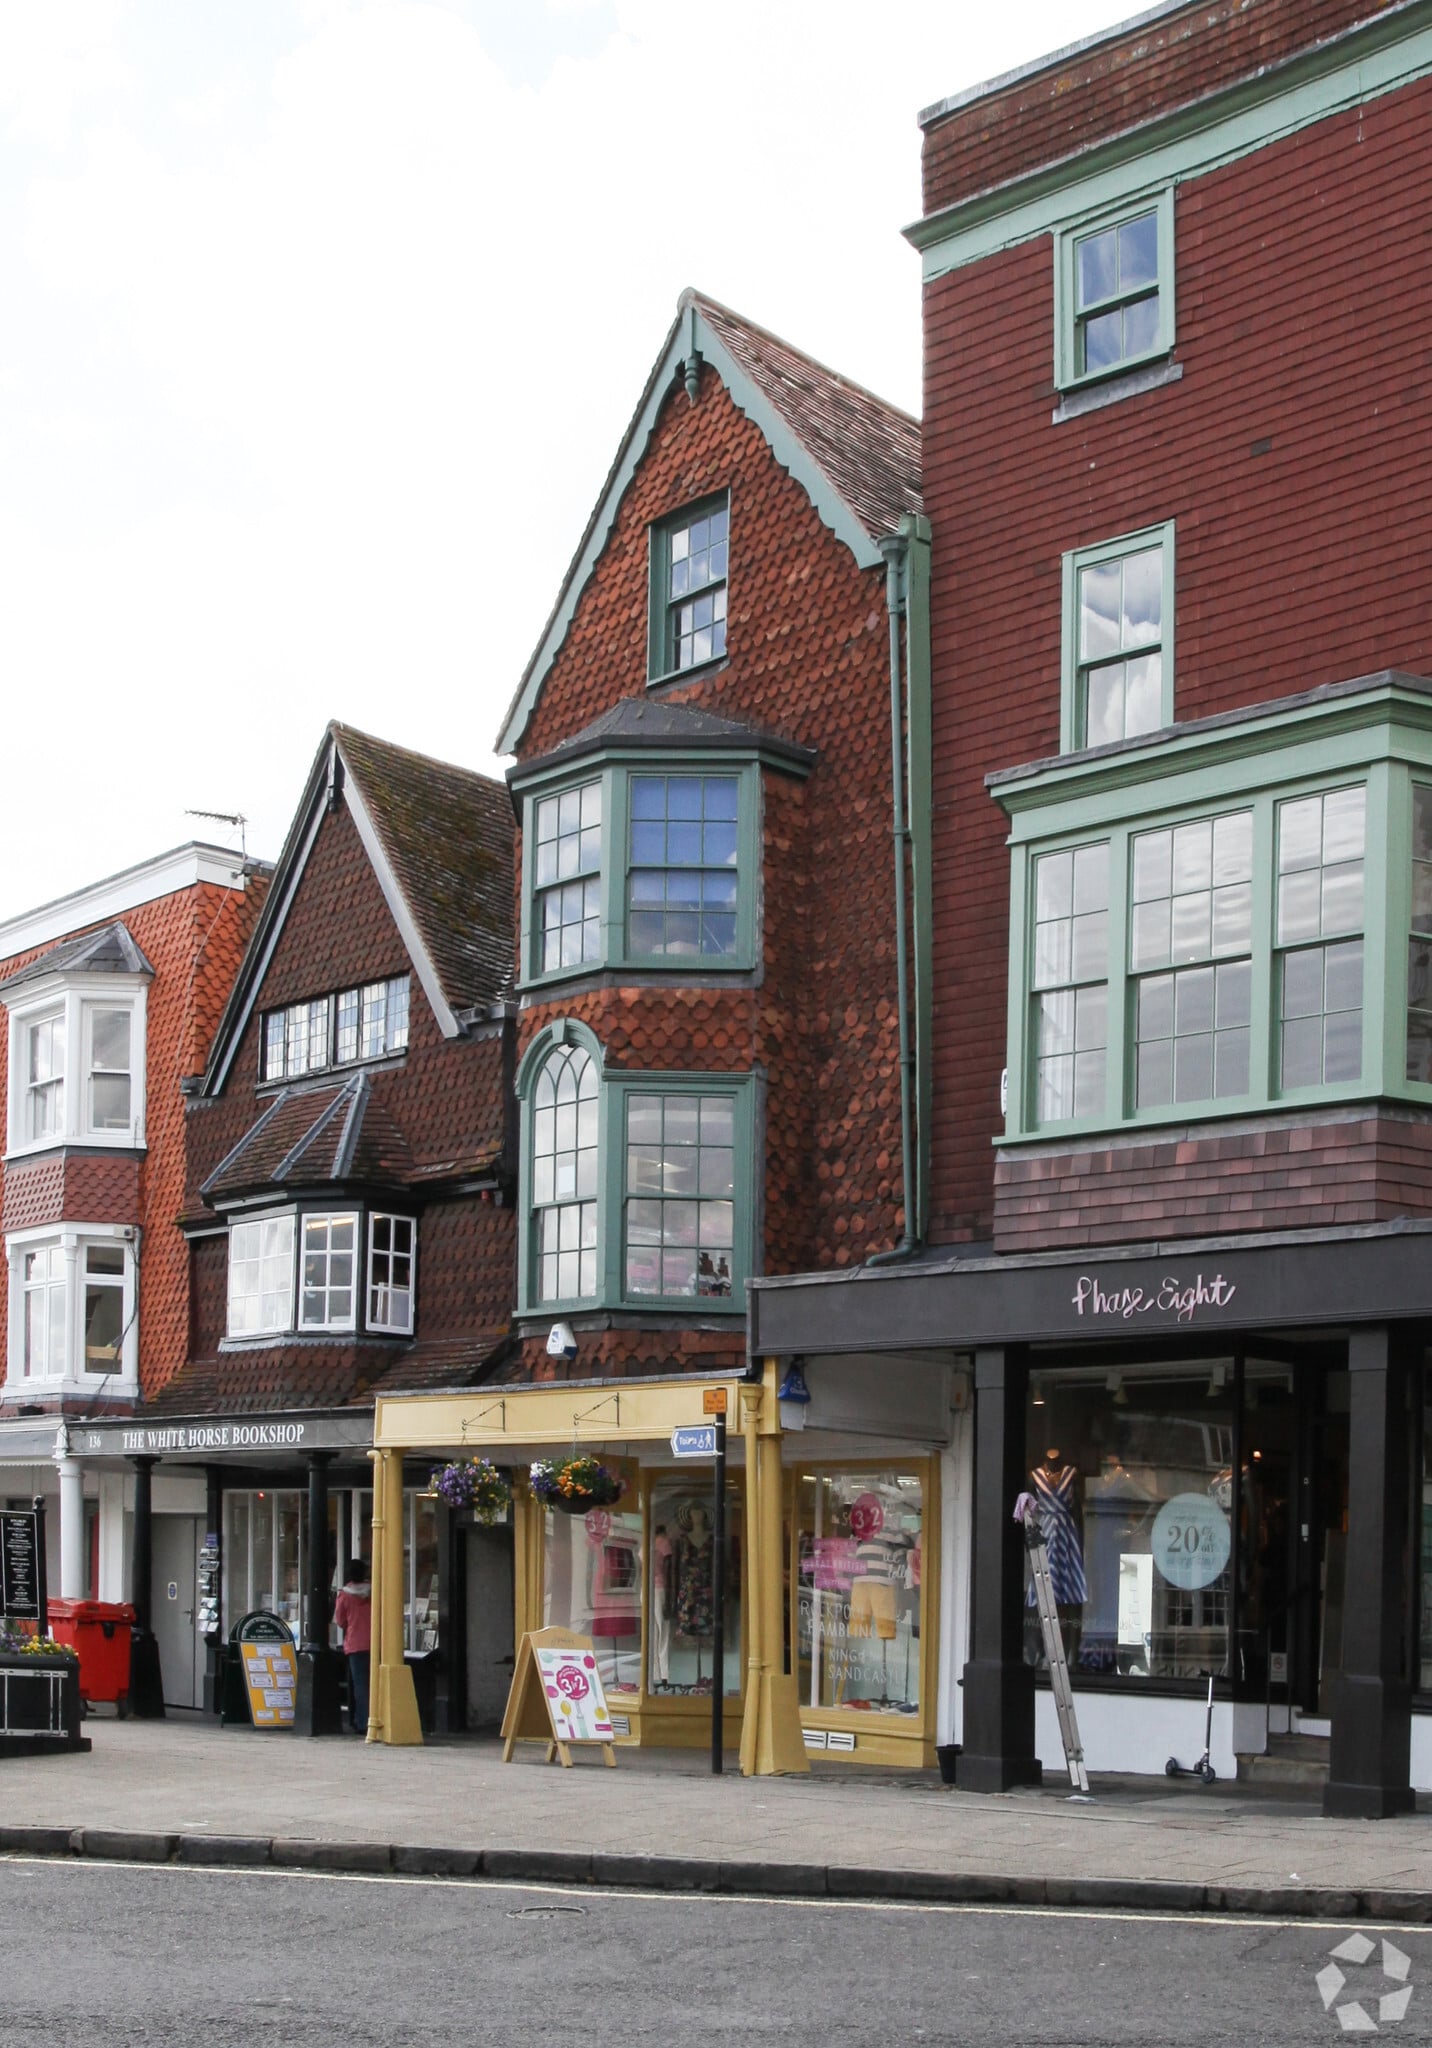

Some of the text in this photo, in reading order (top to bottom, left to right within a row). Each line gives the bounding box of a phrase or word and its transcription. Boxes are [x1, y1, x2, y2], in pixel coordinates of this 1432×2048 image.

[1072, 1274, 1236, 1322] Phase Eight
[89, 1436, 101, 1448] 136
[123, 1424, 304, 1449] THE WHITE HORSE BOOKSHOP
[560, 1678, 573, 1694] 3
[574, 1675, 587, 1691] 2
